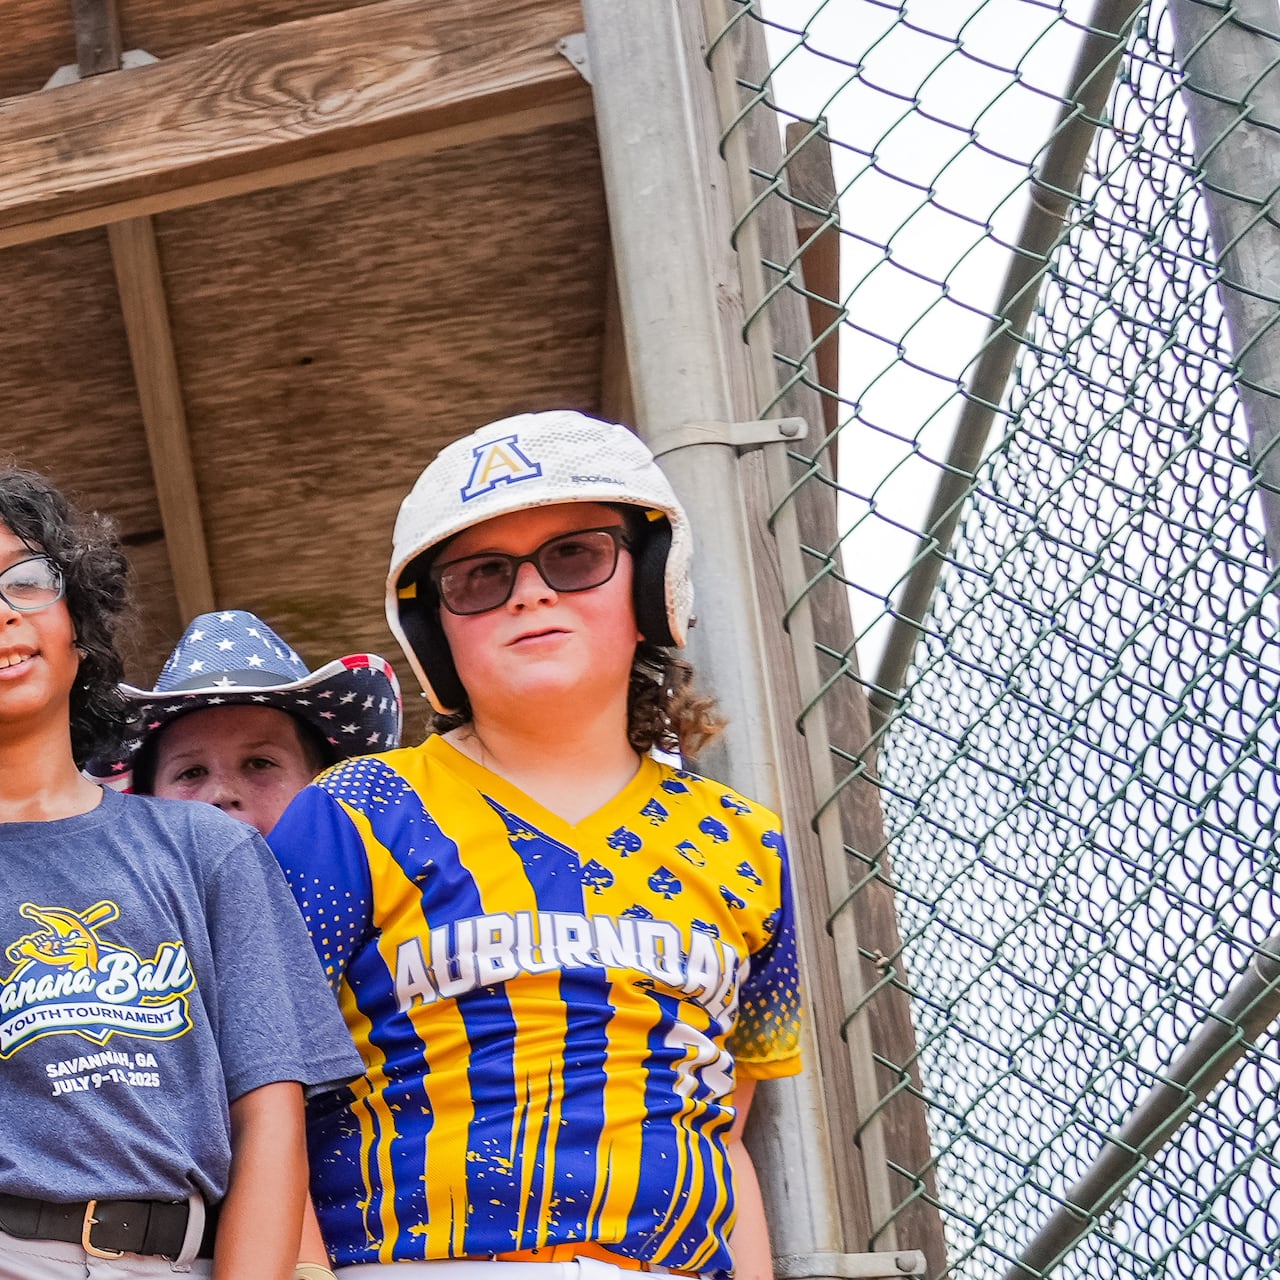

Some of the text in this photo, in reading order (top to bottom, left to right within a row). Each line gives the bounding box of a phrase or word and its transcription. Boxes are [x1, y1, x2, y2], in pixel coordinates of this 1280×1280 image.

[460, 434, 542, 502] A
[96, 945, 191, 1004] Ball
[4, 1007, 176, 1037] YOUTH TOURNAMENT
[45, 1051, 159, 1079] SAVANNAH, GA
[51, 1076, 89, 1098] JULY
[129, 1072, 161, 1089] 2025
